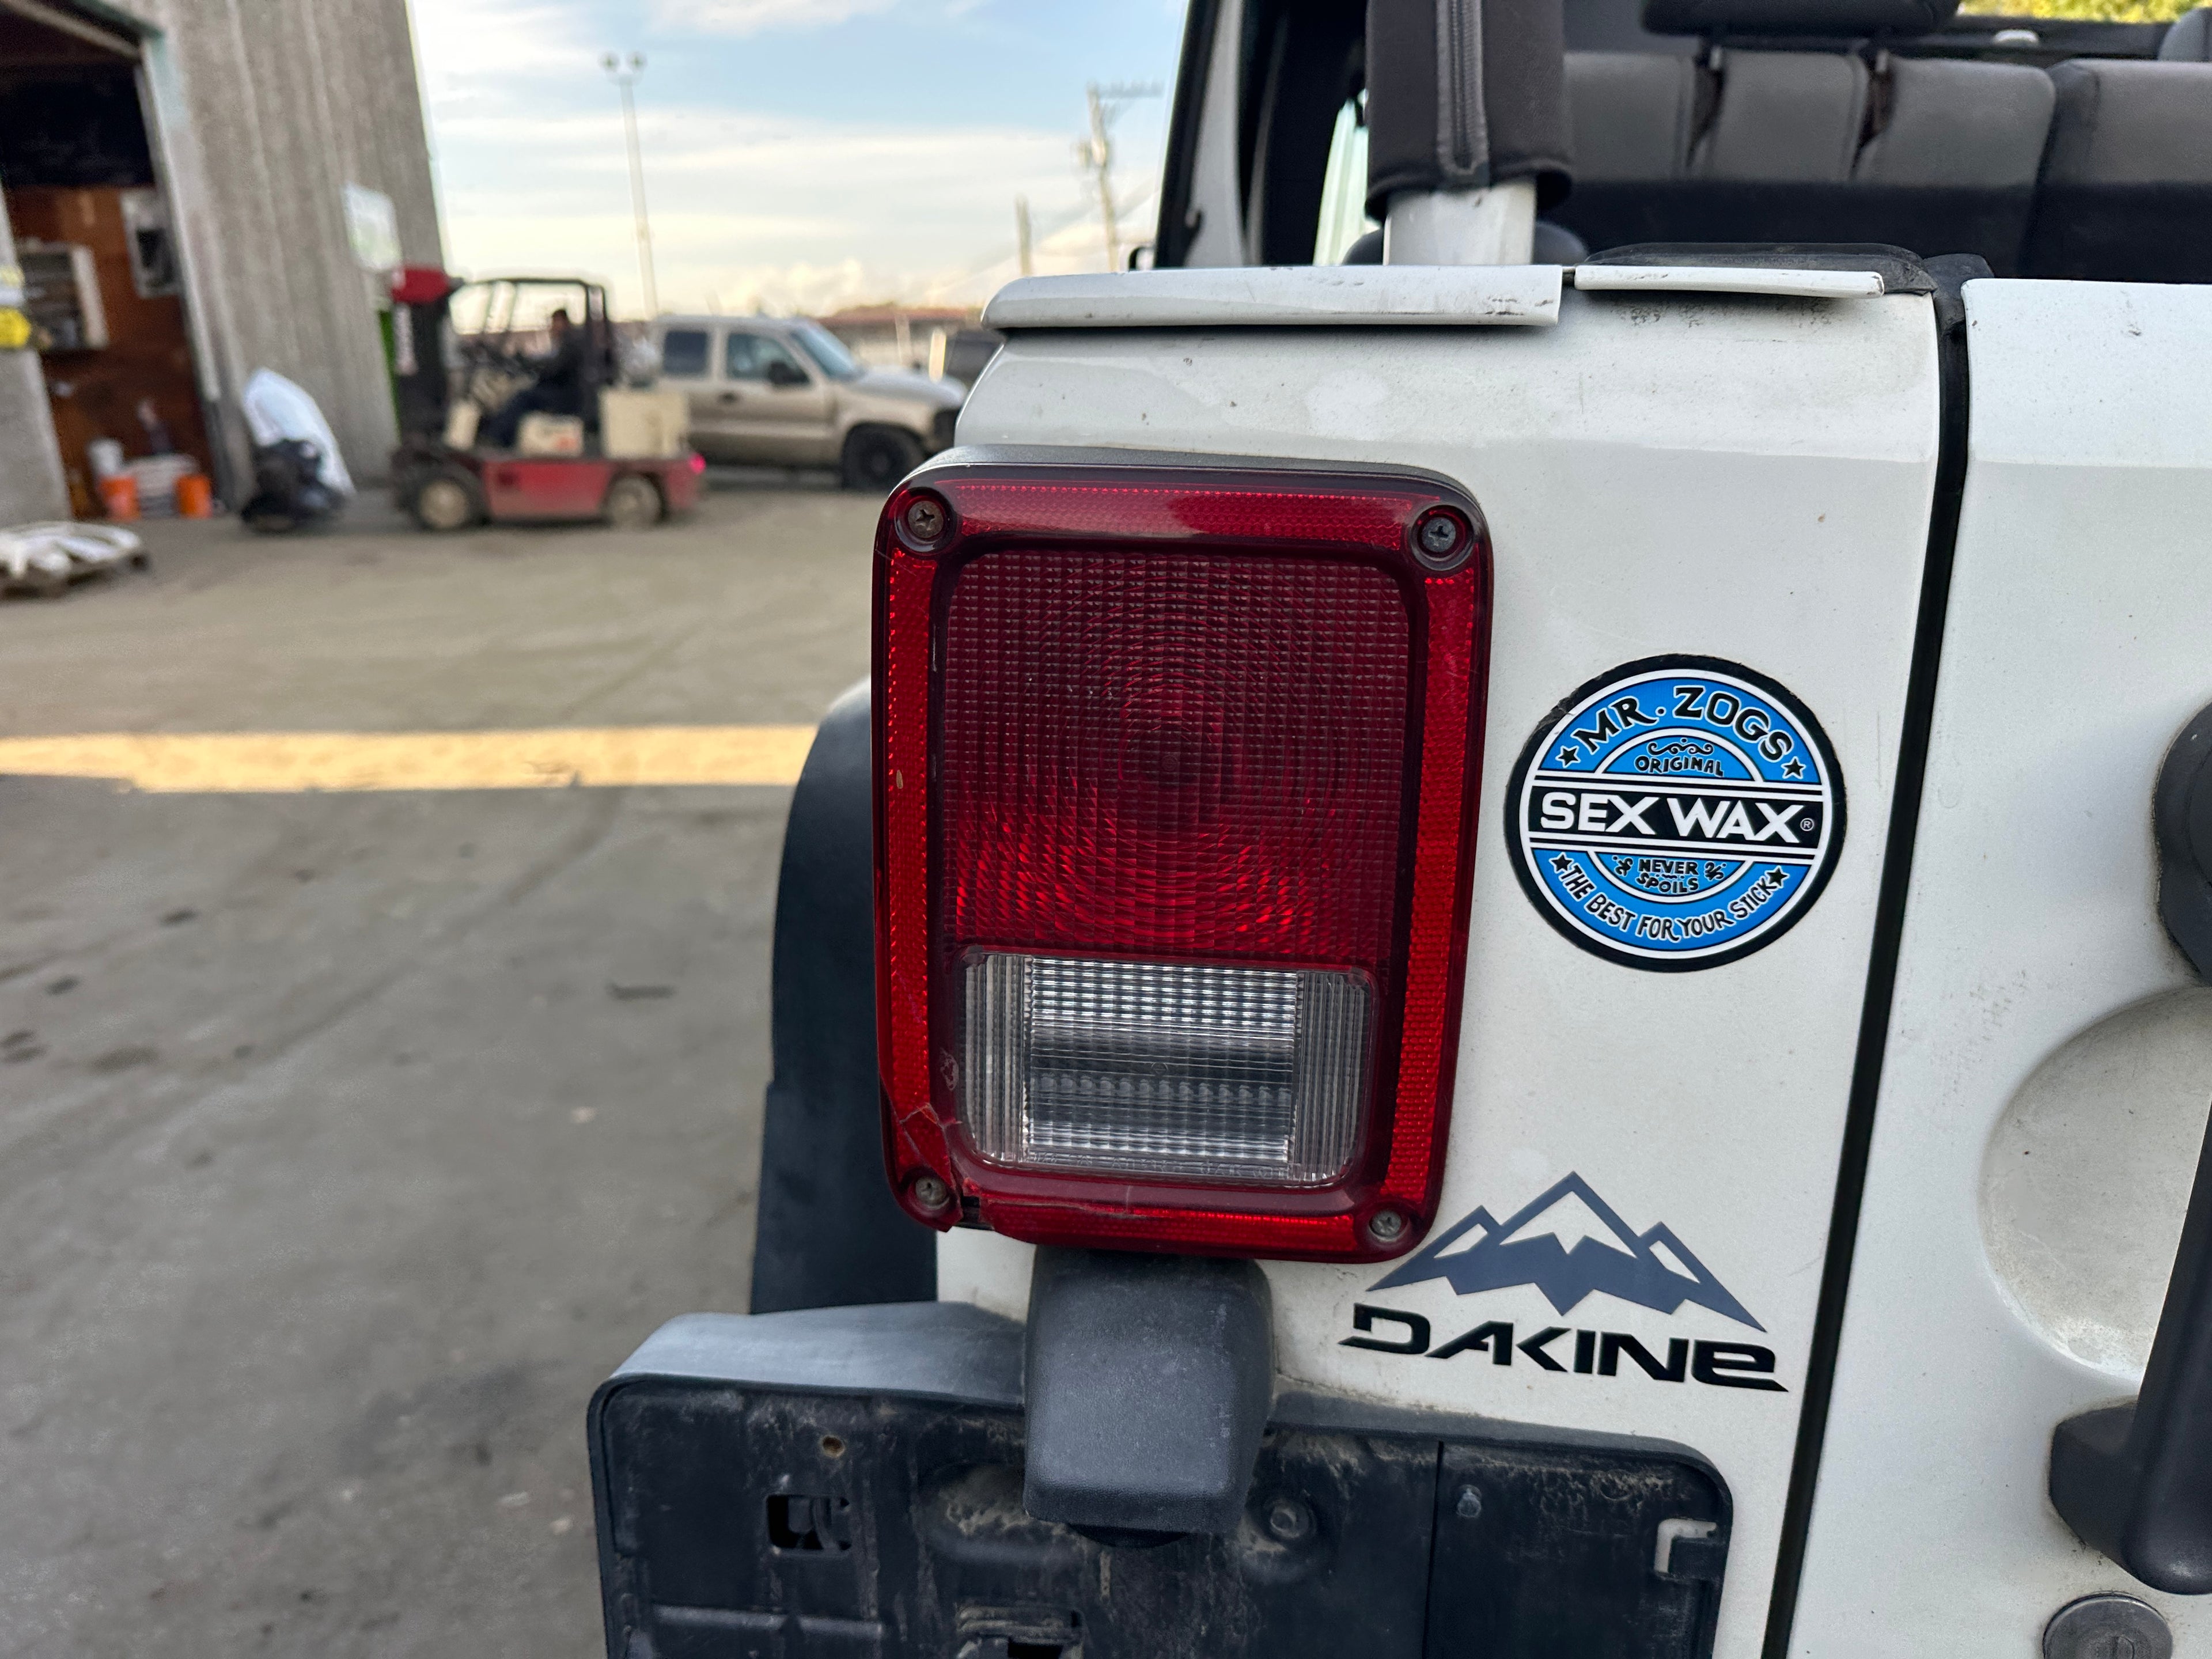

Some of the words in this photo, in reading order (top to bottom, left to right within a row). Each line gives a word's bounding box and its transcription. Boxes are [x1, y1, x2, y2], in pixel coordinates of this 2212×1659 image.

[1574, 697, 1666, 753] MR.
[1673, 686, 1793, 762] ZOGS
[1635, 756, 1724, 777] ORIGINAL
[1540, 791, 1659, 835] SEX
[1638, 858, 1699, 874] NEVER
[1636, 873, 1699, 893] SPOILS
[1560, 864, 1594, 901] THE
[1586, 893, 1636, 931] BEST
[1637, 915, 1680, 942] FOR
[1677, 910, 1734, 935] YOUR
[1730, 879, 1778, 919] STICK
